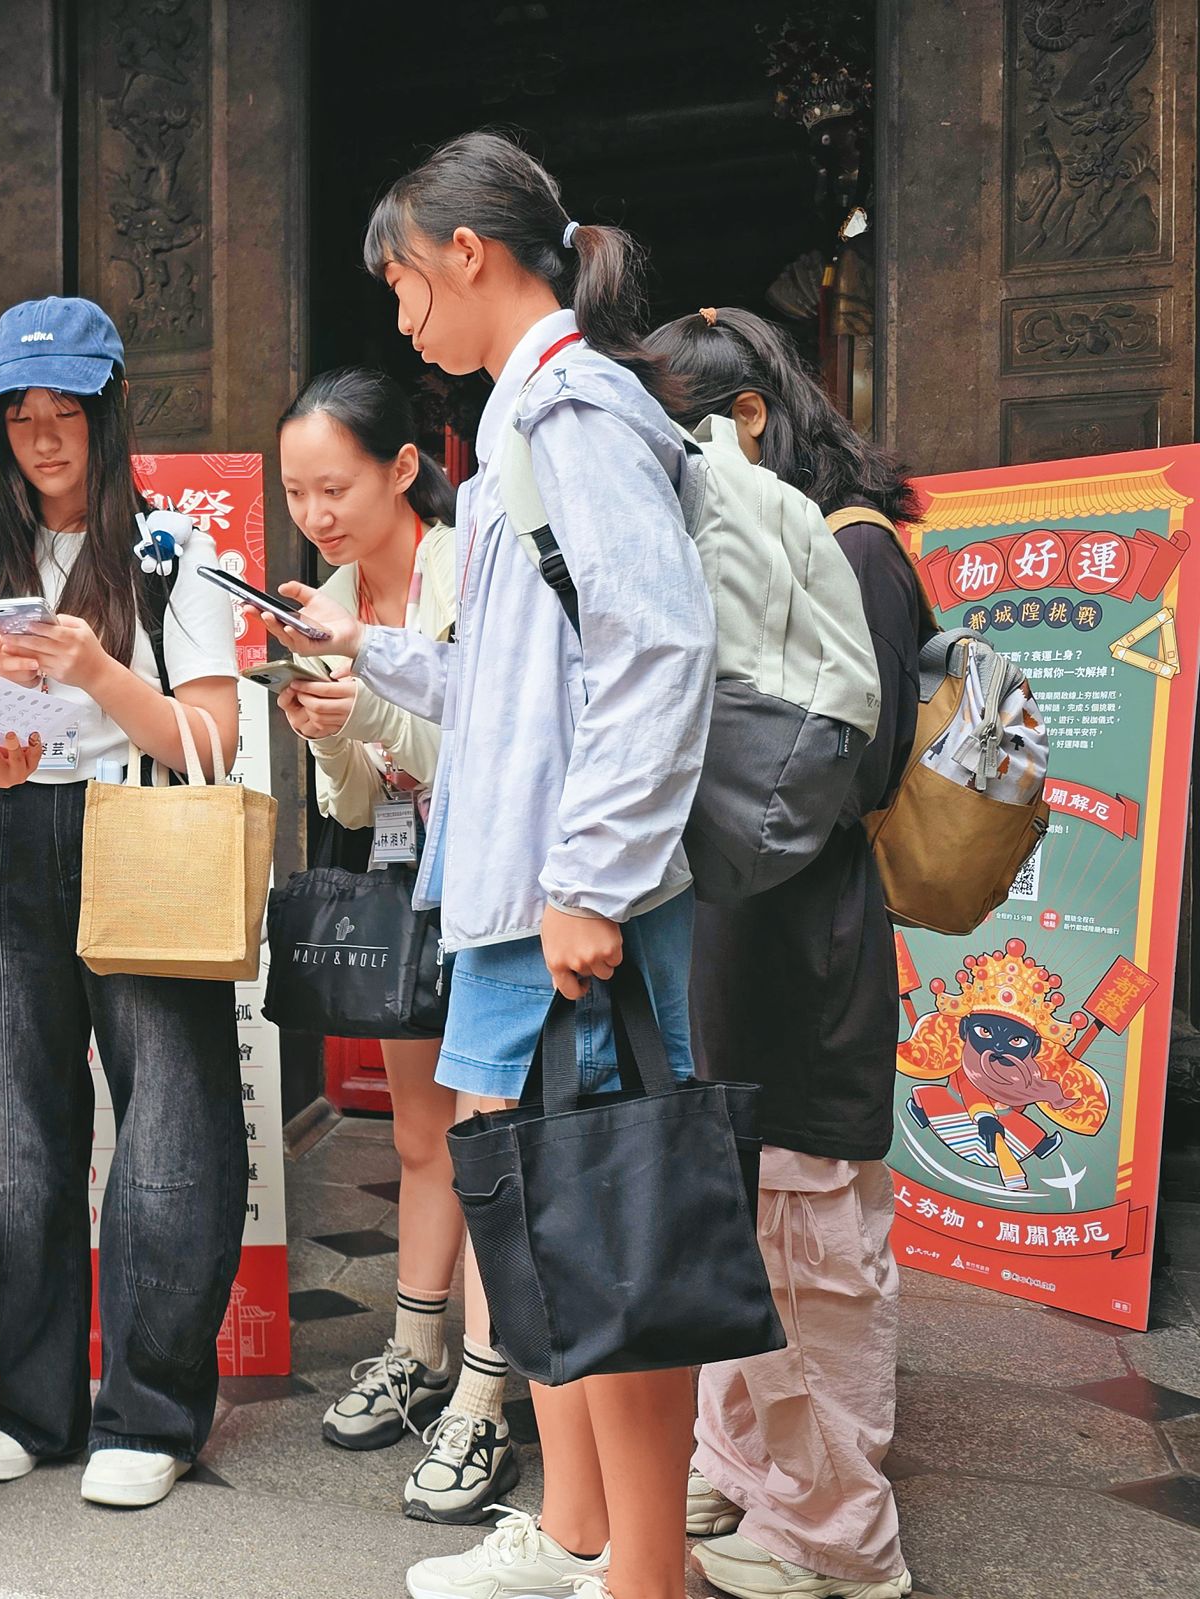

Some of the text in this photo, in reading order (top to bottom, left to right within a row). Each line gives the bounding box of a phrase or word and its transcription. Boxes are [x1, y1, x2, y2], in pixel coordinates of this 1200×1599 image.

[956, 539, 1121, 593] 枷好運
[968, 602, 1097, 631] 都城隍挑戰
[995, 650, 1083, 662] 不斷？衰運上身？
[1020, 667, 1115, 679] 隍爺幫你一次解掉！
[1042, 786, 1110, 821] 關解厄
[348, 951, 388, 968] WOLF
